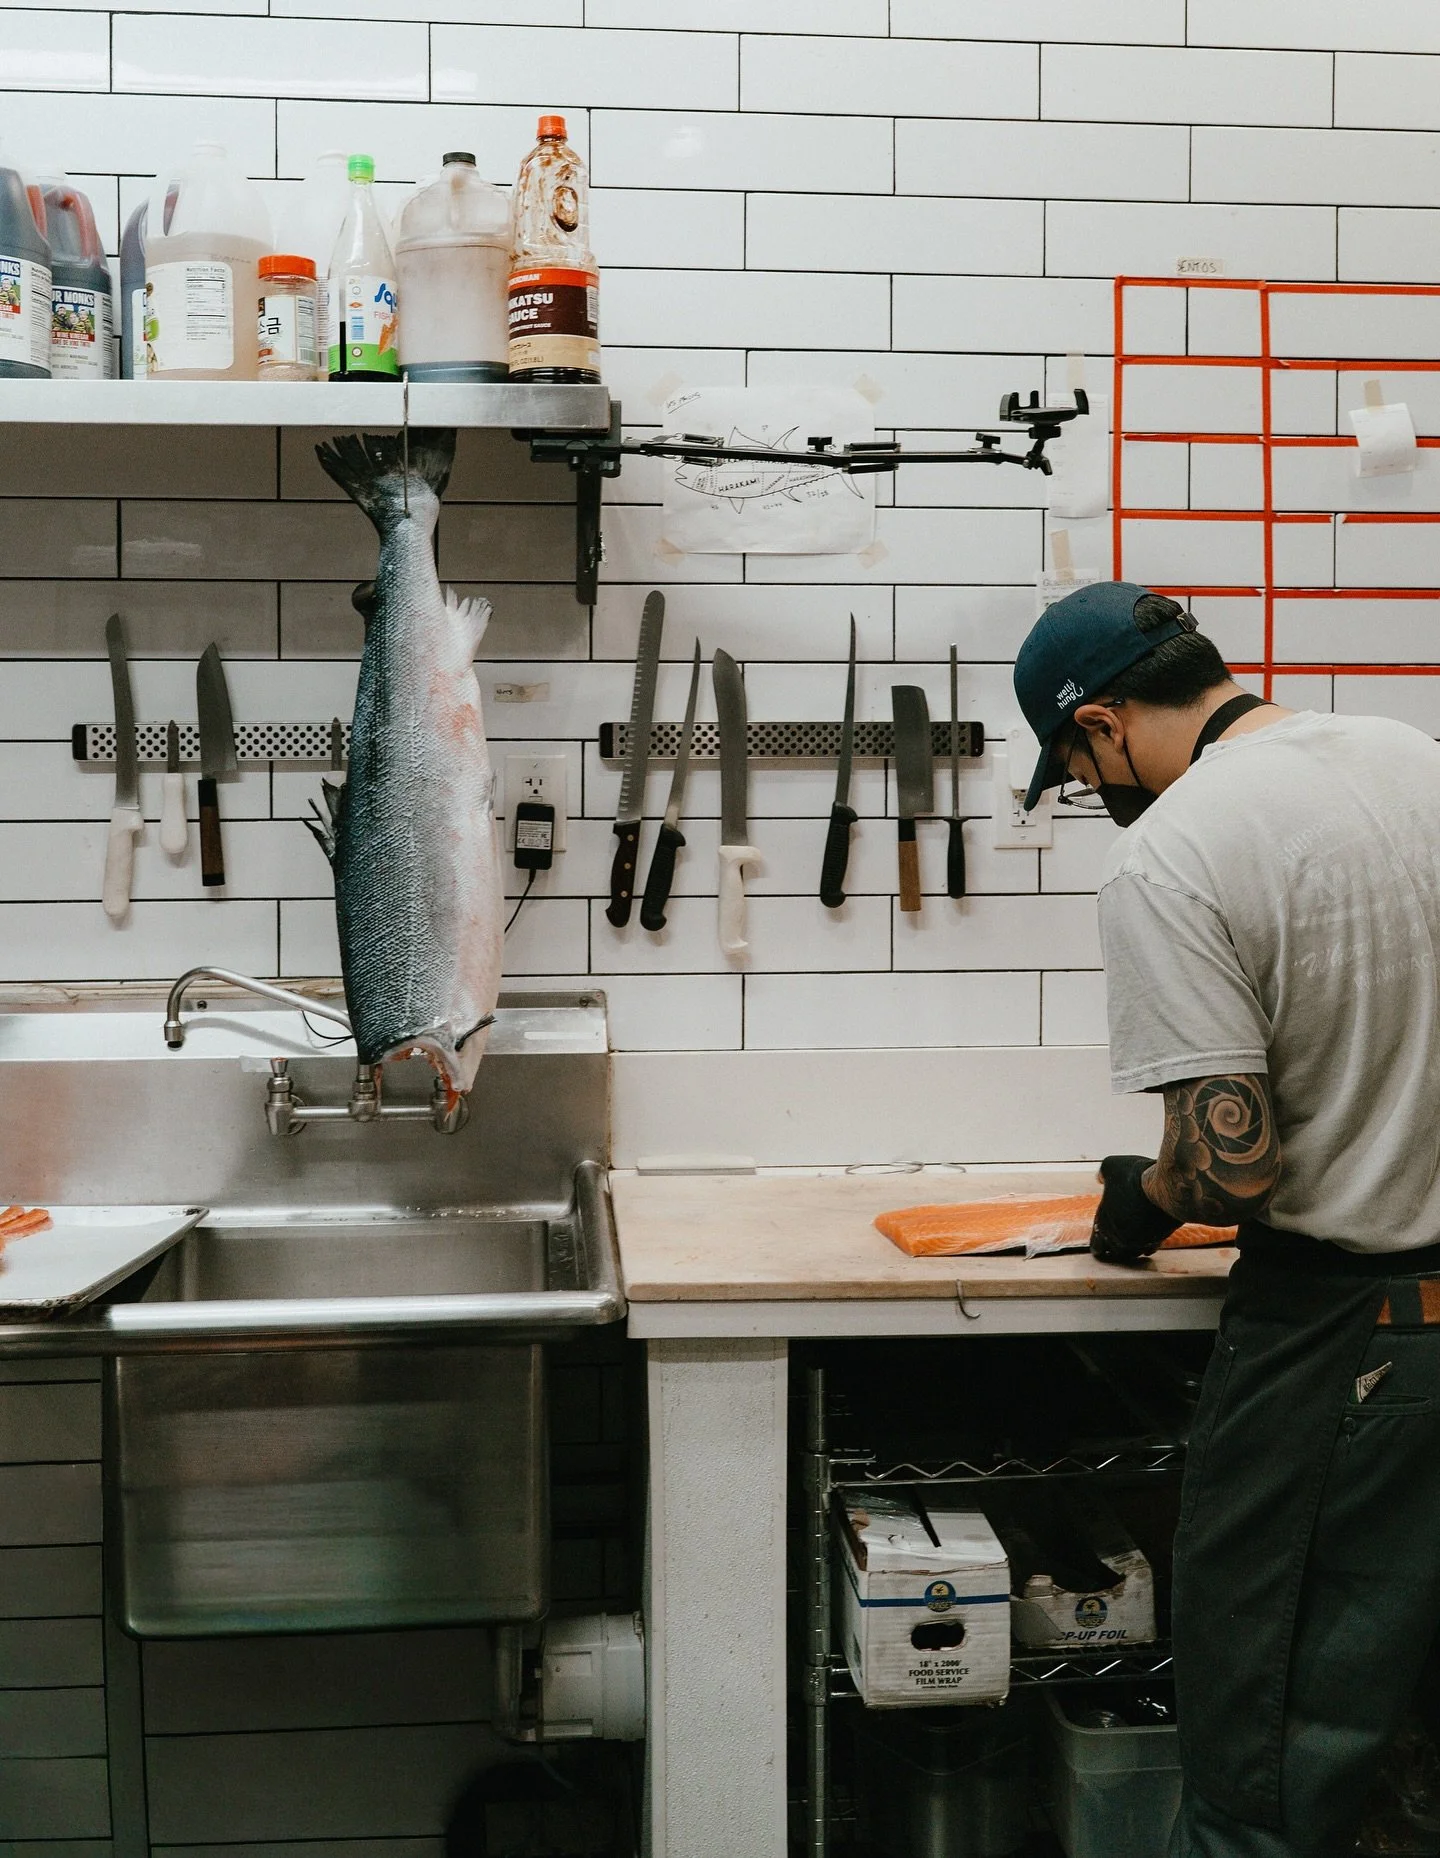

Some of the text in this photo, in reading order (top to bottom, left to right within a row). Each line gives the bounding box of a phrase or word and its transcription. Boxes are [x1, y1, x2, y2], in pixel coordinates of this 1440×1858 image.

[0, 261, 20, 276] NKS
[63, 291, 94, 307] MONKS
[509, 292, 553, 309] KATSU
[509, 308, 538, 325] AUCE
[718, 477, 760, 492] HARAKAMI
[1056, 683, 1073, 700] well
[1057, 691, 1077, 710] hung
[1098, 1629, 1129, 1640] FOIL
[908, 1667, 970, 1677] FOOD SERVICE
[916, 1676, 962, 1686] FILM WRAP
